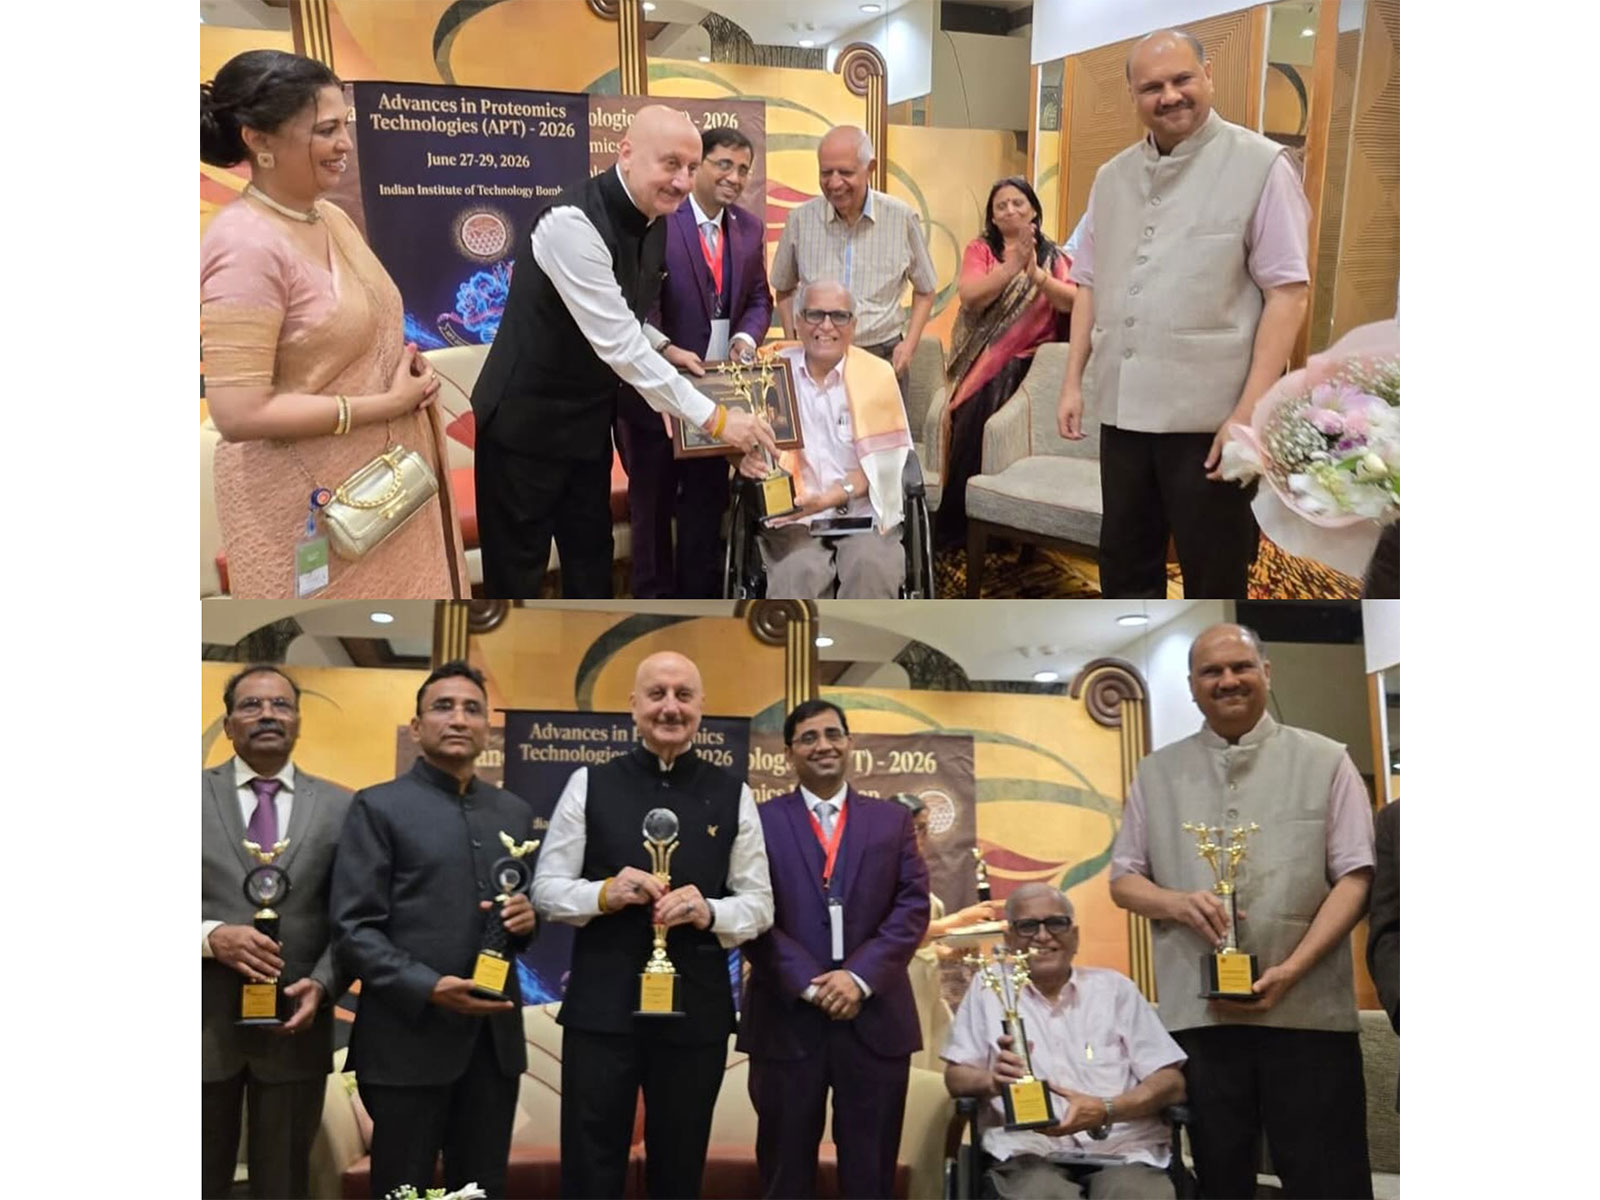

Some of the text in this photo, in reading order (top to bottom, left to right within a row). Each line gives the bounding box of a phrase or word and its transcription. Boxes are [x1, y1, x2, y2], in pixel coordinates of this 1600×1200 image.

[378, 93, 458, 114] Advances
[460, 97, 477, 114] in
[481, 99, 567, 119] Proteomics
[370, 113, 479, 137] Technologies
[482, 118, 526, 139] (APT)
[539, 122, 576, 138] 2026
[427, 152, 531, 168] June 27-29, 2026
[379, 184, 416, 196] Indian
[417, 184, 463, 196] Institute
[464, 184, 476, 196] of
[477, 184, 534, 199] Technology
[530, 722, 609, 741] Advances
[612, 724, 628, 741] in
[888, 750, 937, 774] 2026
